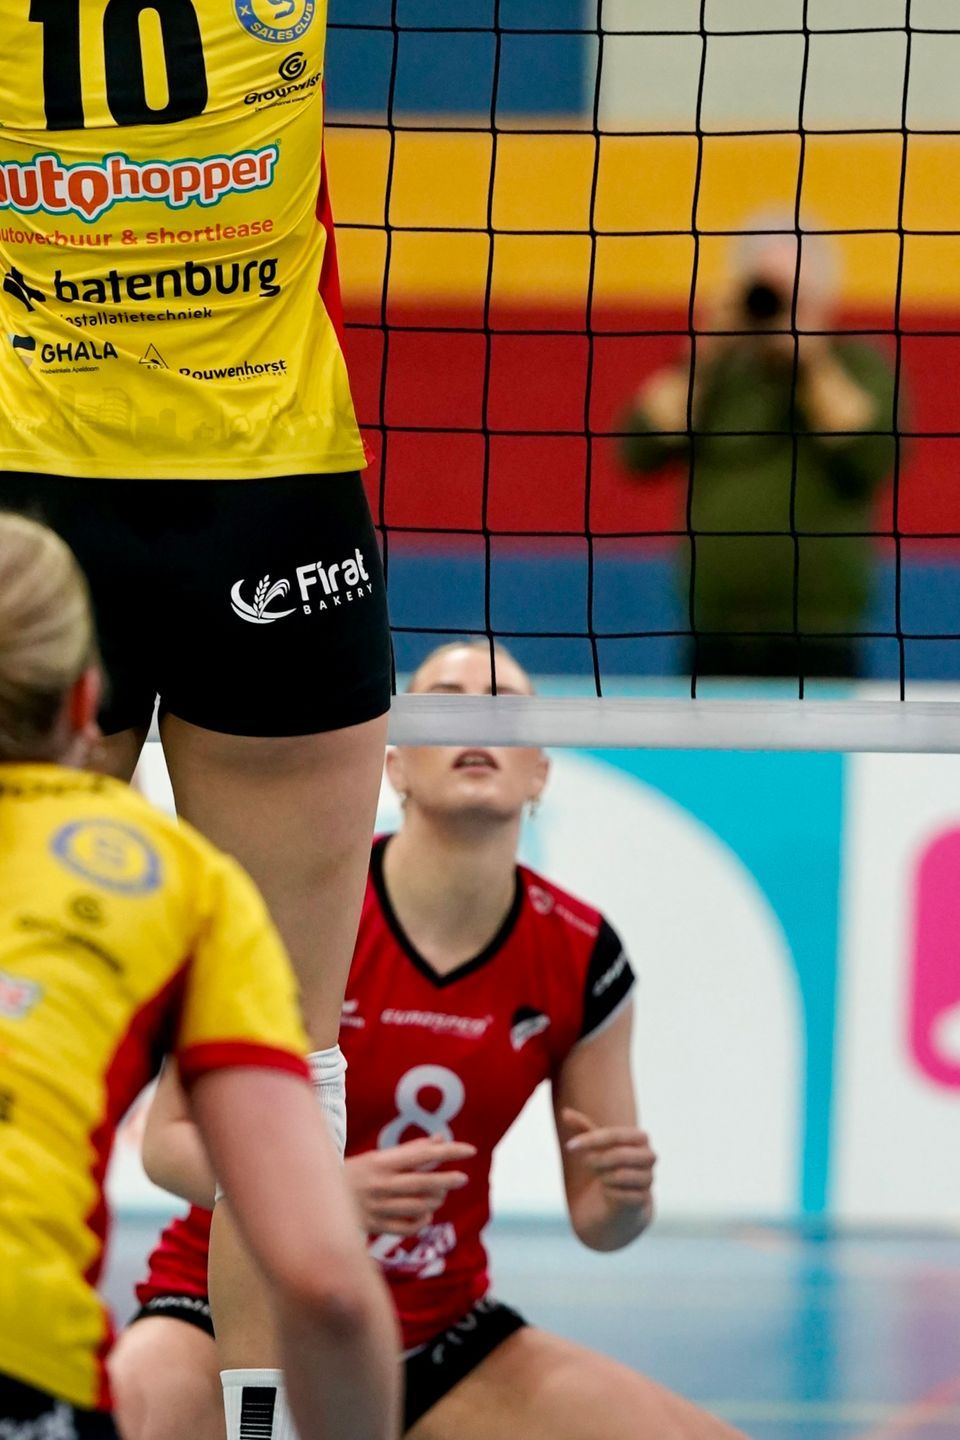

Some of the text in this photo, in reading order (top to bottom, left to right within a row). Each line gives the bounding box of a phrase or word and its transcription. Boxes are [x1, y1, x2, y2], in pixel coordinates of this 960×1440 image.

[250, 3, 313, 40] SALES CLUB
[0, 218, 274, 247] utoverhuur & shortlease
[54, 258, 280, 303] batenburg
[60, 307, 212, 328] nstallatietechniek
[41, 341, 118, 363] GHALA
[296, 548, 369, 601] Firat
[303, 583, 373, 615] BAKERY
[377, 1063, 465, 1171] 8
